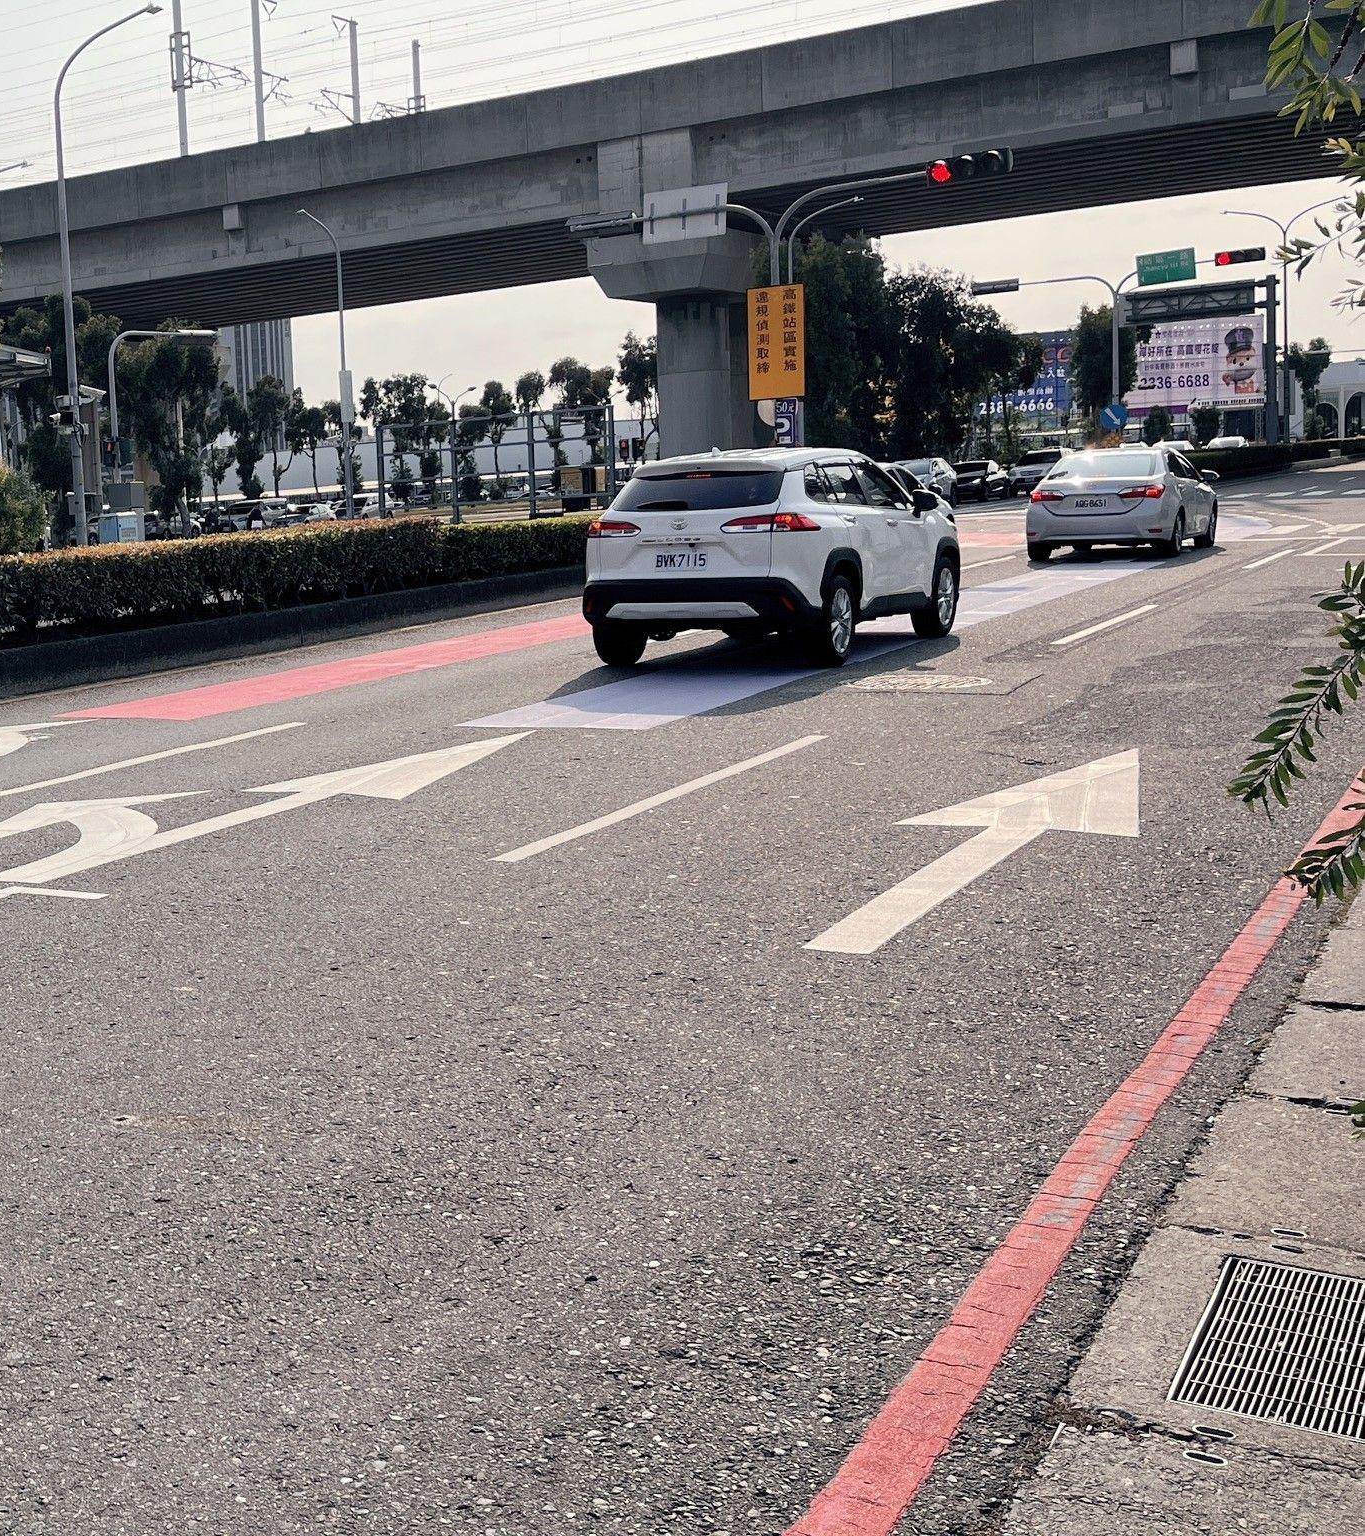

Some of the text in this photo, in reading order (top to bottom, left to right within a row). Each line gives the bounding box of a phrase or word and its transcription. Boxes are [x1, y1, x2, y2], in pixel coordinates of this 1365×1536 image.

[755, 290, 771, 375] 違規偵測取締
[782, 287, 798, 372] 高鐵站區實施
